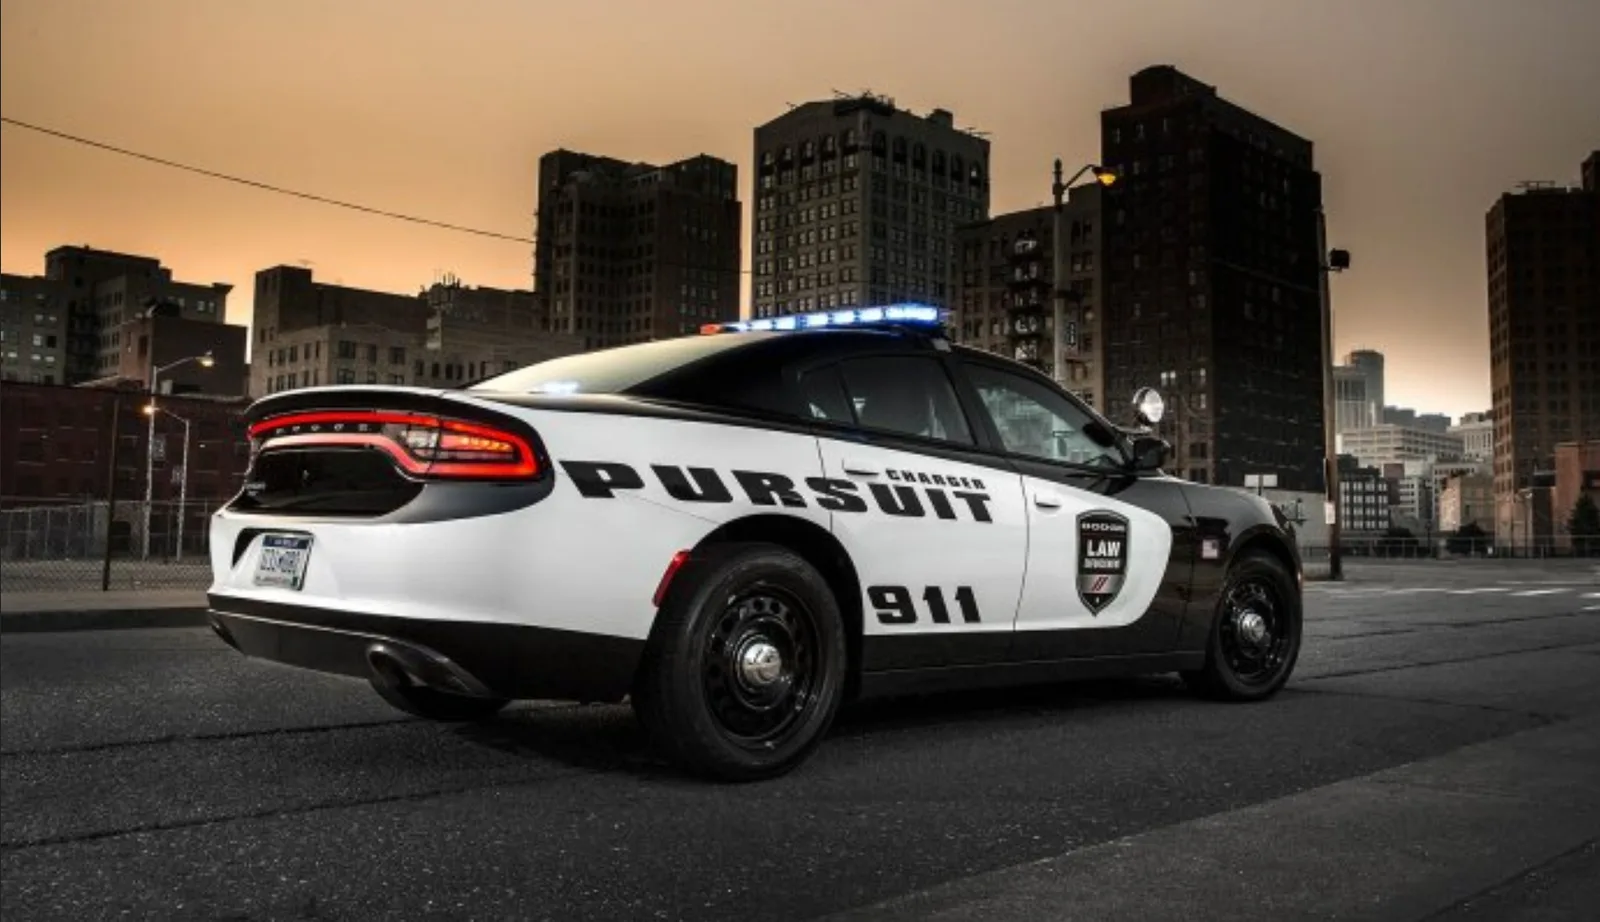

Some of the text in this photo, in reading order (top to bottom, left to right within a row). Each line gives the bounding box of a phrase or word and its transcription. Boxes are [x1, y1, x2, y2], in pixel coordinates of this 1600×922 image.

[558, 460, 993, 523] PURSUIT
[885, 468, 986, 490] CHARGER
[1087, 539, 1120, 557] LAW
[867, 585, 981, 625] 911
